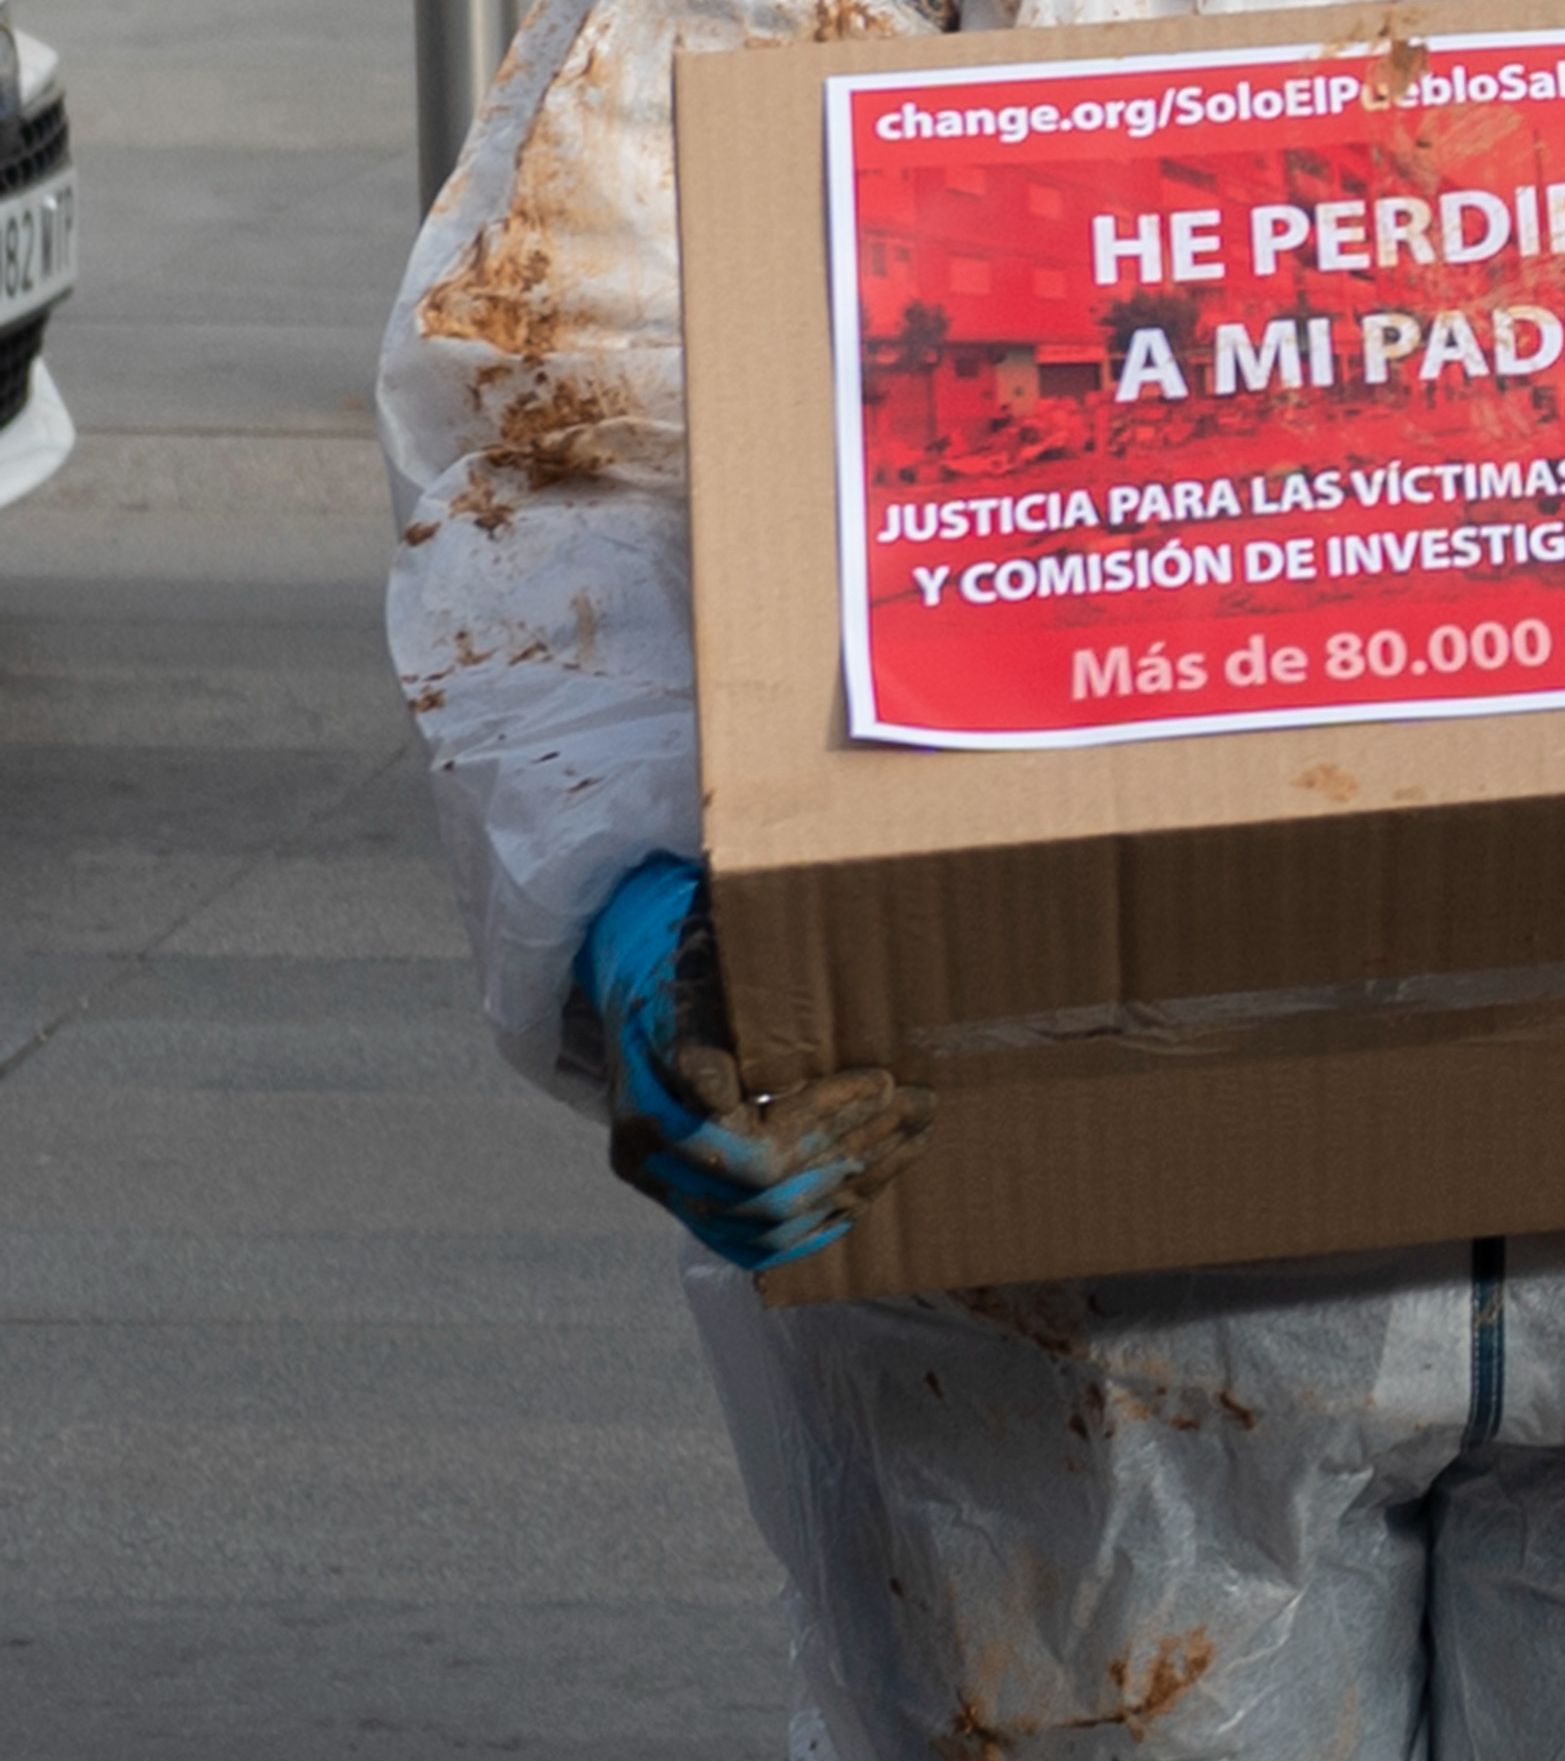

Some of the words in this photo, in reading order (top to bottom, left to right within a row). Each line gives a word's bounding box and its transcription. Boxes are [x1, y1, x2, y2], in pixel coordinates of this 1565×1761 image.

[0, 209, 34, 299] 82
[1093, 209, 1225, 285] HE
[1115, 328, 1188, 402] A
[1215, 317, 1334, 395] MI
[876, 490, 1099, 543] JUSTICIA
[1109, 479, 1241, 525] PARA
[1251, 471, 1344, 514] LAS
[913, 565, 950, 606] Y
[961, 538, 1232, 603] COMISIÓN
[1245, 538, 1317, 582] DE
[1072, 641, 1208, 700] Más
[1224, 634, 1308, 687] de
[1325, 618, 1552, 680] 80.000
